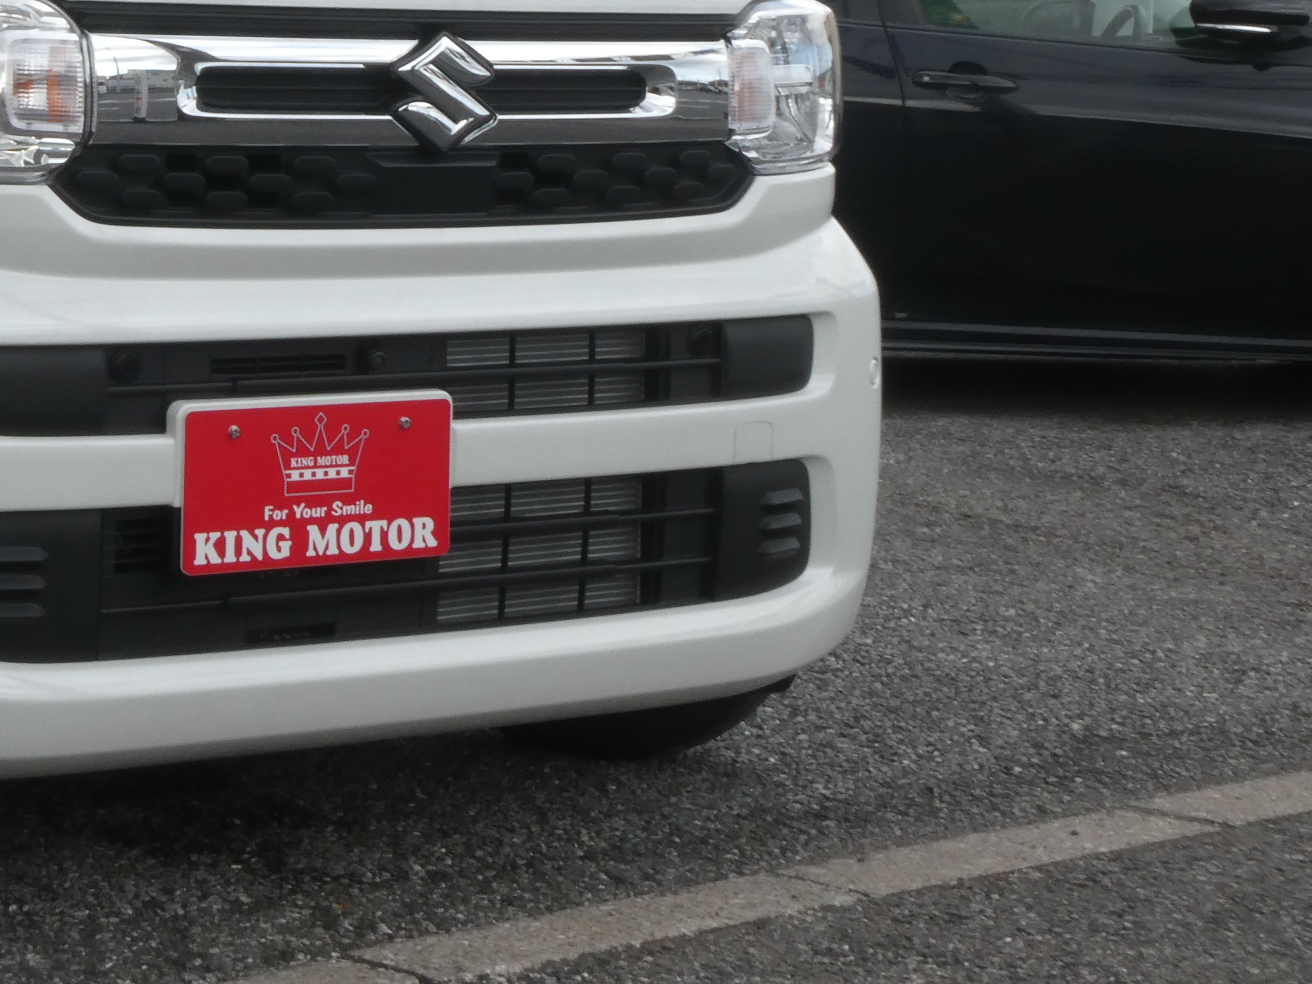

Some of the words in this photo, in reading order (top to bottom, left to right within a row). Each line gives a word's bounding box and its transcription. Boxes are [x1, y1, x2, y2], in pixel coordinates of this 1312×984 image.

[290, 456, 315, 468] KING
[316, 454, 350, 466] MOTOR
[264, 505, 288, 521] For
[293, 502, 328, 519] Your
[331, 500, 373, 517] Smile
[193, 526, 293, 566] KING
[305, 516, 438, 557] MOTOR
